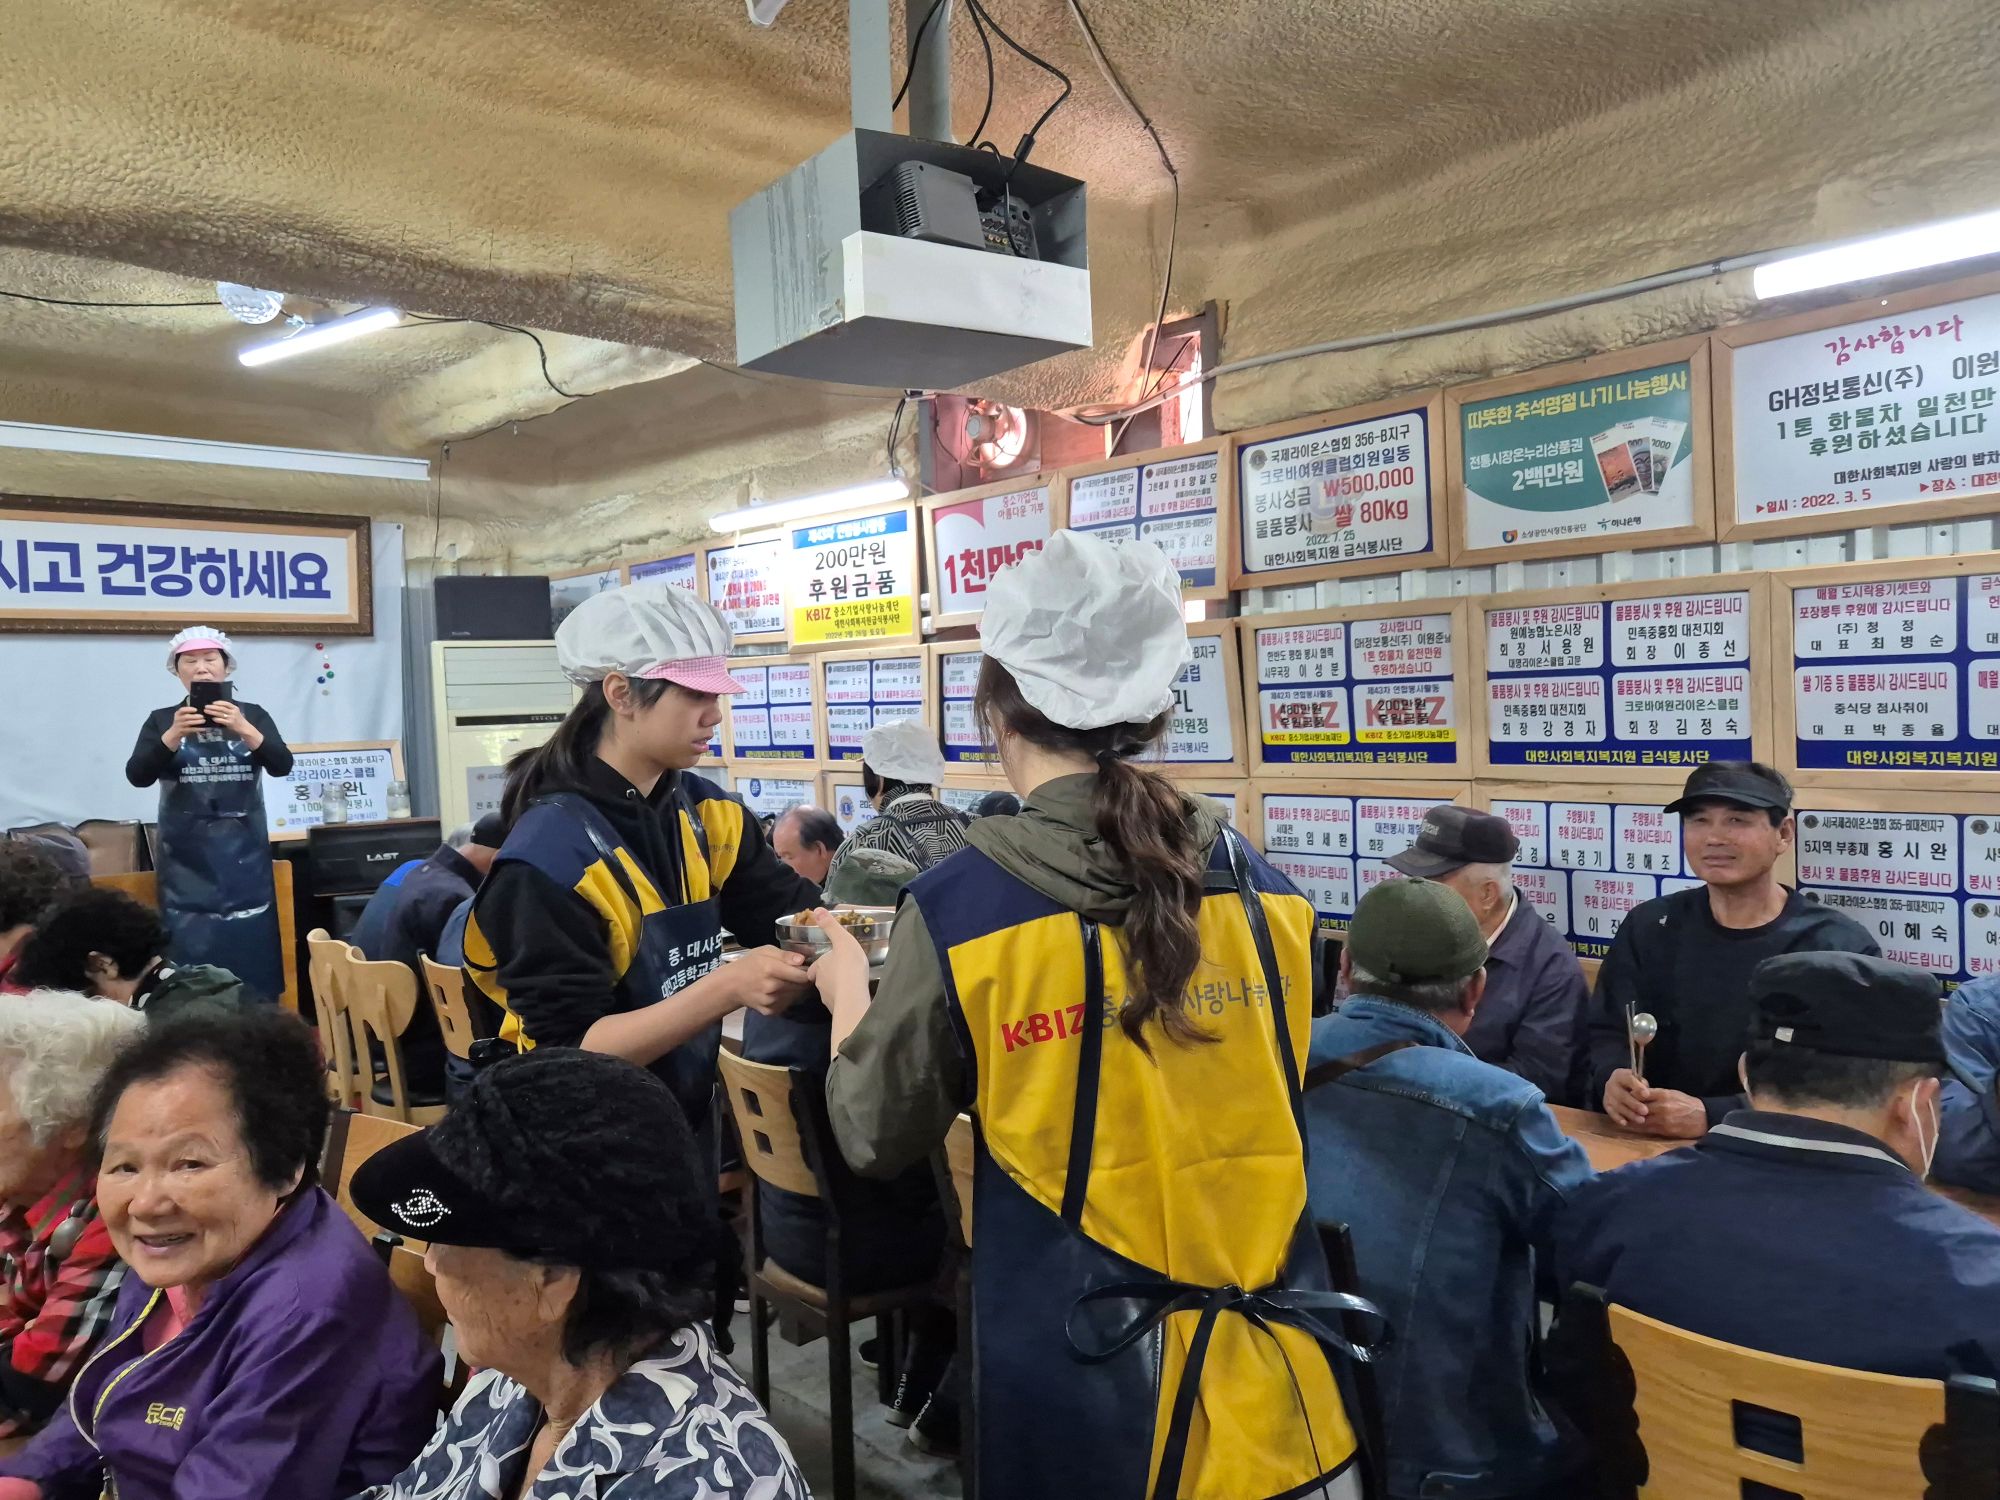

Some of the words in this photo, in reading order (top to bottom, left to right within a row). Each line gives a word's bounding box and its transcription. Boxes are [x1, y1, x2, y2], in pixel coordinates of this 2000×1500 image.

[1824, 315, 1964, 366] 감사합니다
[1769, 365, 1923, 412] GH정보통신(주)
[1468, 406, 1512, 430] 따뜻한
[1515, 392, 1577, 420] 추석명절
[1580, 385, 1613, 408] 나기
[1616, 371, 1687, 400] 나눔행사
[1777, 416, 1813, 439] 1톤
[1828, 402, 1902, 432] 화물차
[1917, 387, 1996, 417] 일천만
[1809, 413, 1987, 456] 후원하셨습니다
[1271, 437, 1351, 462] 국제라이온스협회
[1355, 424, 1410, 447] 356-B지구
[1469, 437, 1583, 470] 전통시장온누리상품권
[1260, 445, 1411, 485] 크로바여원클럽회원일동
[1834, 461, 1921, 484] 대한사회복지원
[1927, 455, 1967, 472] 사랑의
[1512, 459, 1584, 491] 2백만원
[1932, 478, 1955, 492] 장소
[1971, 474, 2000, 487] 대전
[1002, 491, 1039, 508] 중소기업의
[1255, 486, 1311, 513] 봉사성금
[998, 505, 1026, 520] 아름다운
[1030, 502, 1044, 514] 기부
[1256, 513, 1312, 539] 물품봉사
[1335, 505, 1352, 528] 쌀
[1361, 499, 1408, 523] 80kg
[1611, 516, 1641, 527] 하나은행
[816, 540, 886, 570] 200만원
[1264, 548, 1339, 567] 대한사회복지원
[1344, 537, 1402, 557] 급식봉사단
[96, 543, 331, 600] 건강하세요
[944, 539, 1043, 594] 1천만
[809, 570, 896, 602] 후원금품
[1817, 586, 1837, 600] 매월
[1842, 581, 1931, 599] 도시락용기셋트와
[806, 608, 831, 621] KBIZ
[834, 601, 899, 616] 중소기업사랑나눔재단
[1616, 603, 1650, 622] 물품봉사
[1653, 603, 1662, 618] 및
[1665, 602, 1681, 617] 후원
[1685, 597, 1742, 616] 감사드립니다
[1800, 605, 1840, 619] 포장봉투
[1845, 602, 1878, 616] 후원에
[1882, 598, 1950, 615] 감사드립니다
[835, 614, 899, 629] 대한사회복지원급식봉사단
[1491, 612, 1520, 627] 물품봉사
[1522, 610, 1530, 625] 및
[1532, 609, 1548, 624] 후원
[1551, 606, 1599, 623] 감사드립니다
[1380, 619, 1422, 632] 감사합니다
[1510, 624, 1582, 640] 원예농협노은시장
[1628, 624, 1678, 639] 민족중흥회
[1682, 622, 1724, 638] 대전지회
[1261, 631, 1283, 646] 물품봉사
[1292, 630, 1304, 642] 후원
[1306, 628, 1342, 642] 감사드립니다
[1267, 650, 1286, 661] 한반도
[1289, 649, 1302, 661] 평화
[1304, 649, 1317, 659] 봉사
[1363, 652, 1376, 662] 1톤
[1378, 651, 1403, 661] 화물차
[1407, 648, 1442, 660] 일천만원
[1509, 656, 1564, 668] 대명라이온스클럽
[1567, 656, 1581, 666] 고문
[1265, 666, 1290, 678] 사무국장
[1372, 662, 1432, 674] 후원하셨습니다
[1393, 684, 1439, 694] 연합봉사활동
[1617, 678, 1651, 695] 물품봉사
[1655, 680, 1663, 694] 및
[1665, 678, 1683, 693] 후원
[1687, 676, 1743, 693] 감사드립니다
[1803, 676, 1811, 693] 쌀
[1814, 675, 1832, 692] 기증
[1836, 675, 1843, 692] 등
[1848, 673, 1885, 691] 물품봉사
[1889, 671, 1948, 690] 감사드립니다
[1293, 689, 1333, 699] 연합봉사활동
[1492, 683, 1521, 699] 물품봉사
[1523, 682, 1531, 698] 및
[1534, 683, 1549, 698] 후원
[1551, 681, 1600, 697] 감사드립니다
[1503, 704, 1547, 717] 민족중흥회
[1550, 704, 1586, 716] 대전지회
[1624, 698, 1739, 712] 크로바여원라이온스클럽
[1834, 702, 1871, 715] 중식당
[1288, 733, 1342, 742] 중소기업사랑나눔재단
[1386, 731, 1449, 740] 중소기업사랑나눔재단
[1171, 742, 1208, 753] 급식봉사단
[1291, 752, 1374, 763] 대한사회복지복지원
[1377, 752, 1428, 762] 급식봉사단
[1525, 750, 1636, 764] 대한사회복지복지원
[1641, 751, 1710, 764] 급식봉사단
[1847, 750, 1997, 766] 대한사회복지복지원
[1269, 807, 1291, 820] 물품봉사
[1300, 809, 1312, 821] 후원
[1314, 809, 1350, 822] 감사드립니다
[1360, 806, 1386, 818] 물품봉사
[1397, 806, 1410, 819] 후원
[1505, 808, 1526, 821] 주방봉사
[1567, 810, 1588, 823] 주방봉사
[1632, 812, 1655, 826] 주방봉사
[1276, 824, 1293, 834] 서대전
[1375, 823, 1405, 835] 대전봉사
[1558, 827, 1569, 840] 후원
[1571, 826, 1603, 841] 감사드립니다
[1624, 829, 1635, 842] 후원
[1637, 829, 1672, 844] 감사드립니다
[1271, 837, 1299, 847] 농협조합장
[1369, 839, 1384, 851] 회장
[1804, 841, 1832, 854] 5지역
[1836, 842, 1869, 856] 부총재
[366, 853, 399, 862] LAST
[1293, 866, 1305, 877] 후원
[1308, 866, 1347, 880] 감사드립니다
[1362, 871, 1376, 883] 봉사
[1801, 866, 1821, 880] 봉사
[1826, 867, 1835, 881] 및
[1839, 868, 1881, 883] 물품후원
[1885, 870, 1951, 887] 감사드립니다
[1594, 879, 1624, 895] 주방봉사
[1969, 875, 1992, 890] 봉사
[1584, 896, 1598, 909] 후원
[1970, 958, 1993, 973] 봉사
[1001, 1003, 1085, 1052] KBIZ
